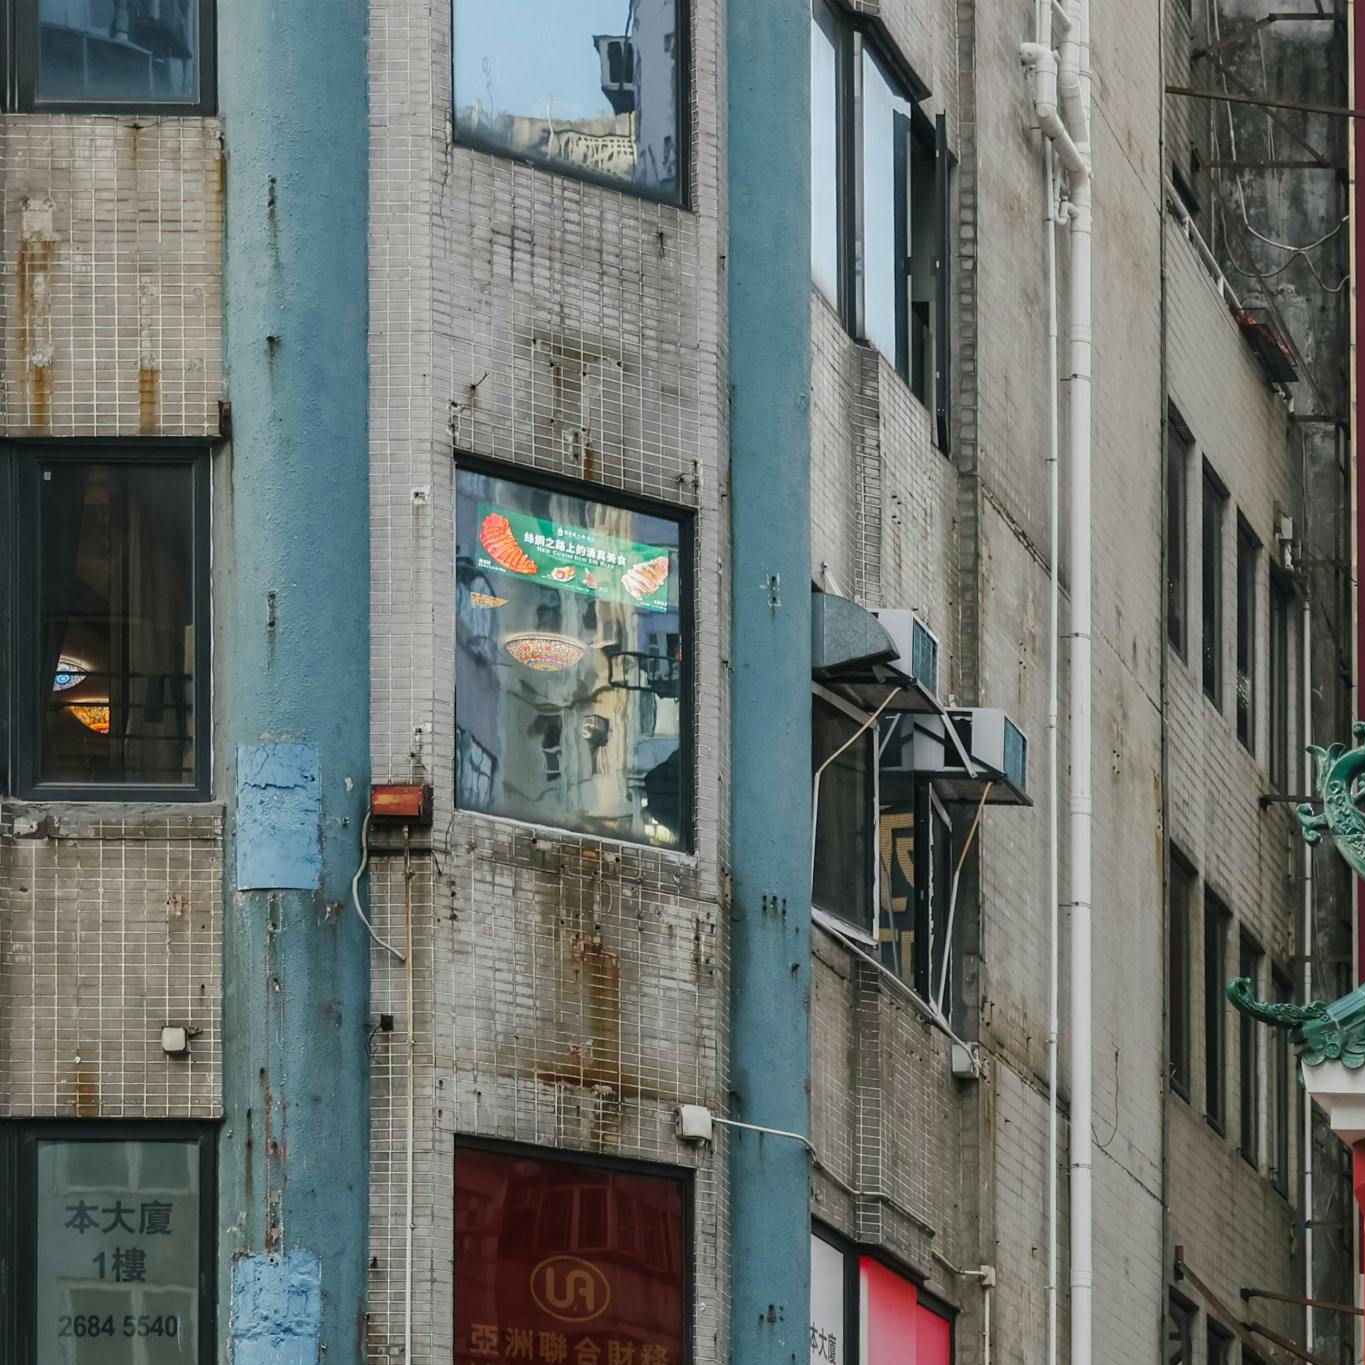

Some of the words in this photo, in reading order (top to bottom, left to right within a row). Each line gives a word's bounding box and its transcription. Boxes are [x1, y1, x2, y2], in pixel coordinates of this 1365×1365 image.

[64, 1200, 174, 1235] 本大廈
[91, 1247, 147, 1282] 1樓
[58, 1314, 116, 1338] 2684
[122, 1314, 178, 1338] 5540
